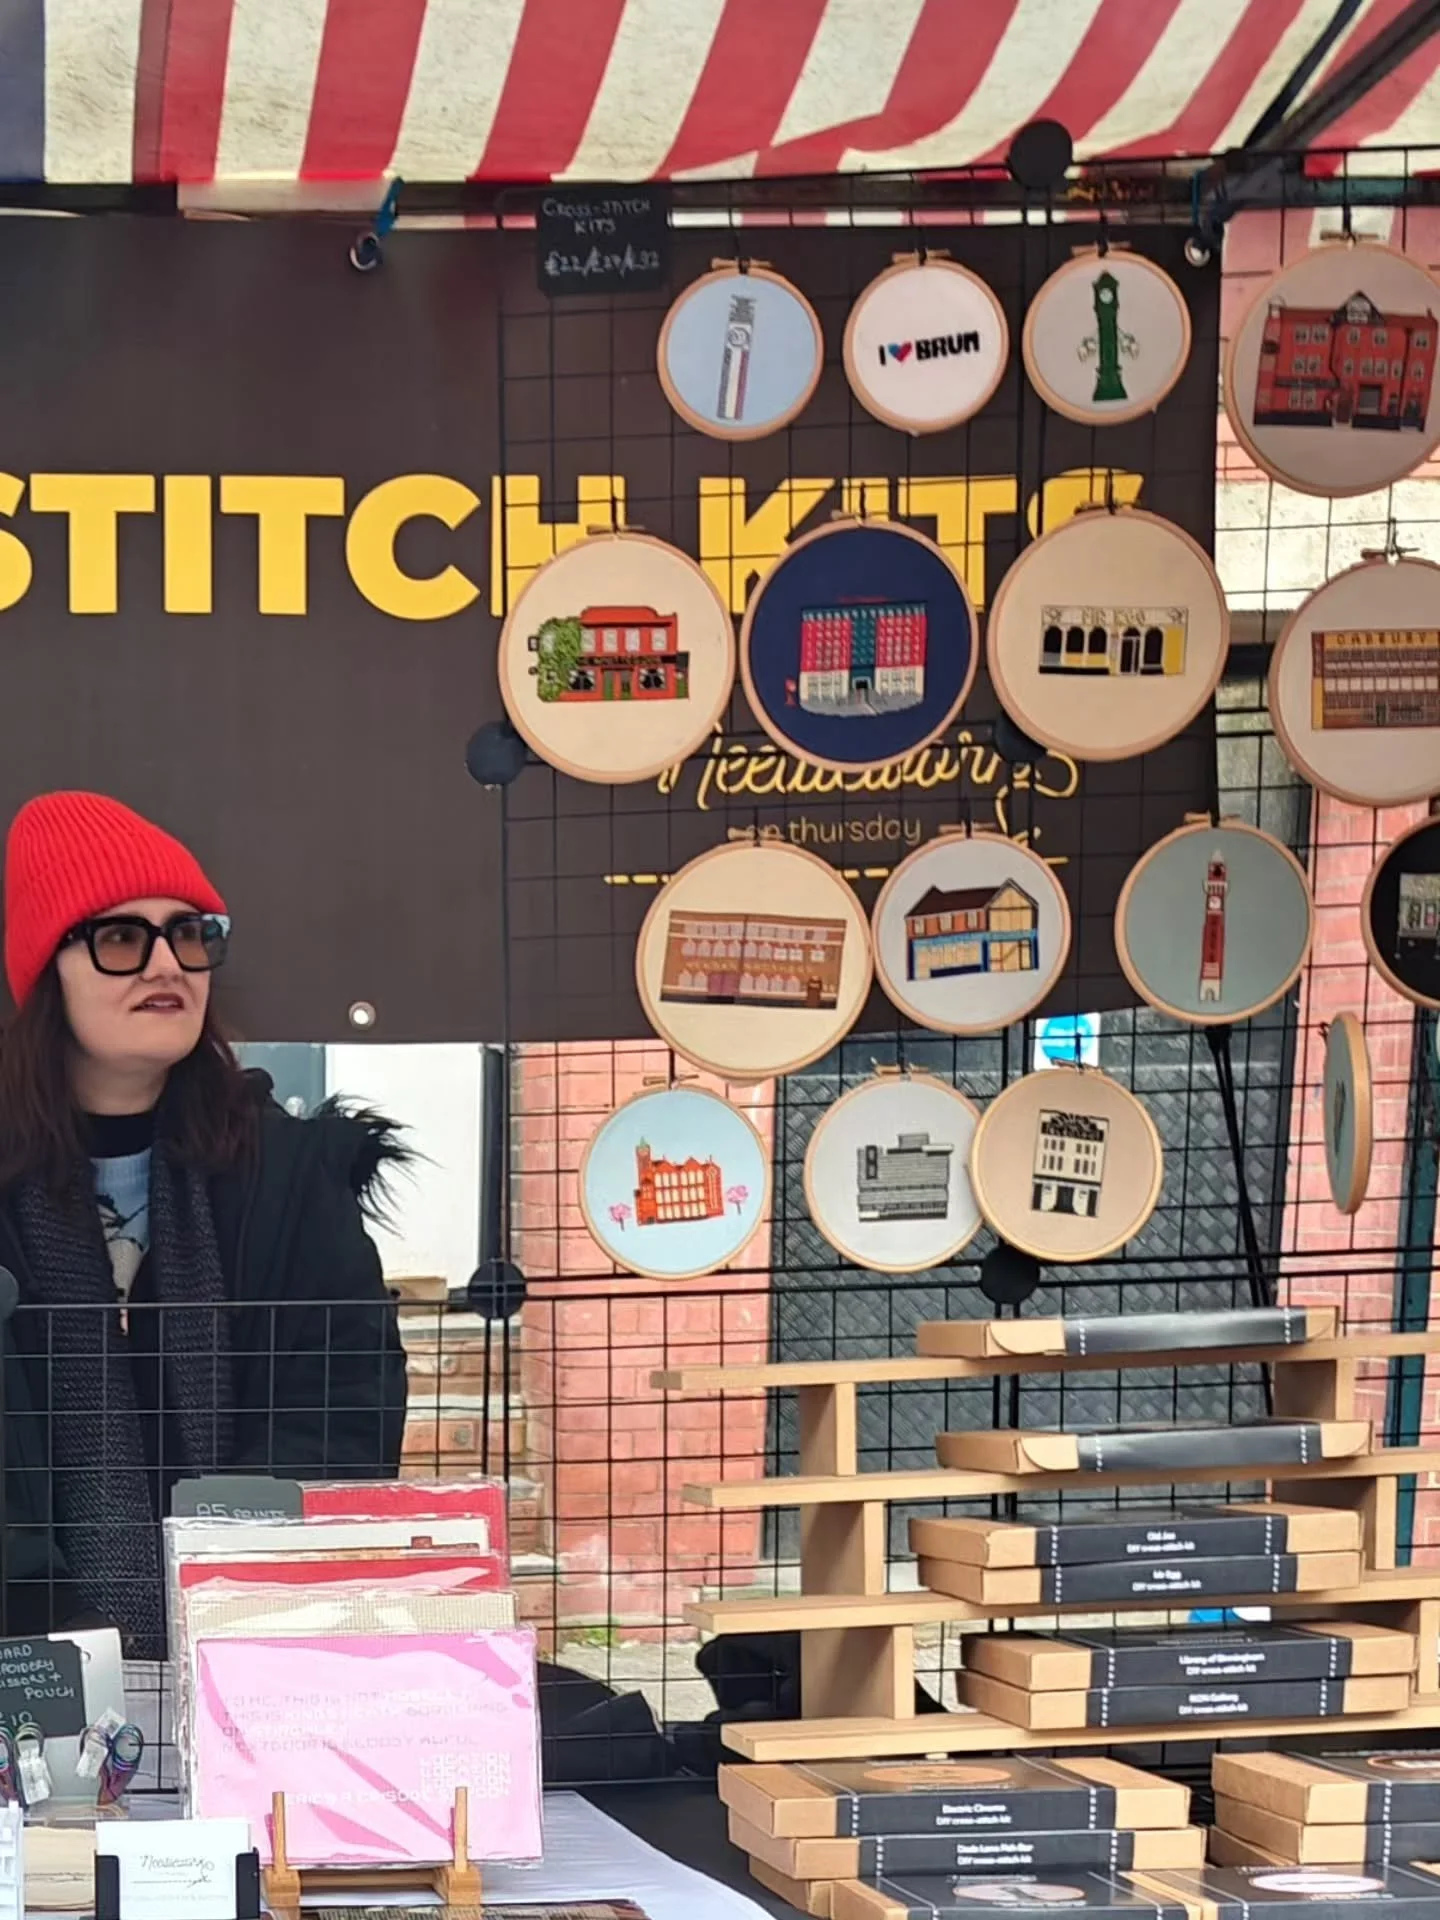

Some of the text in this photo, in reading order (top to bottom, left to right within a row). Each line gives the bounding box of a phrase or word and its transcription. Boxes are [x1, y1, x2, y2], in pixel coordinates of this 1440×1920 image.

[575, 218, 616, 235] KITS
[879, 331, 980, 366] I BRUM
[790, 816, 921, 845] thursday
[24, 1686, 75, 1700] POUCH
